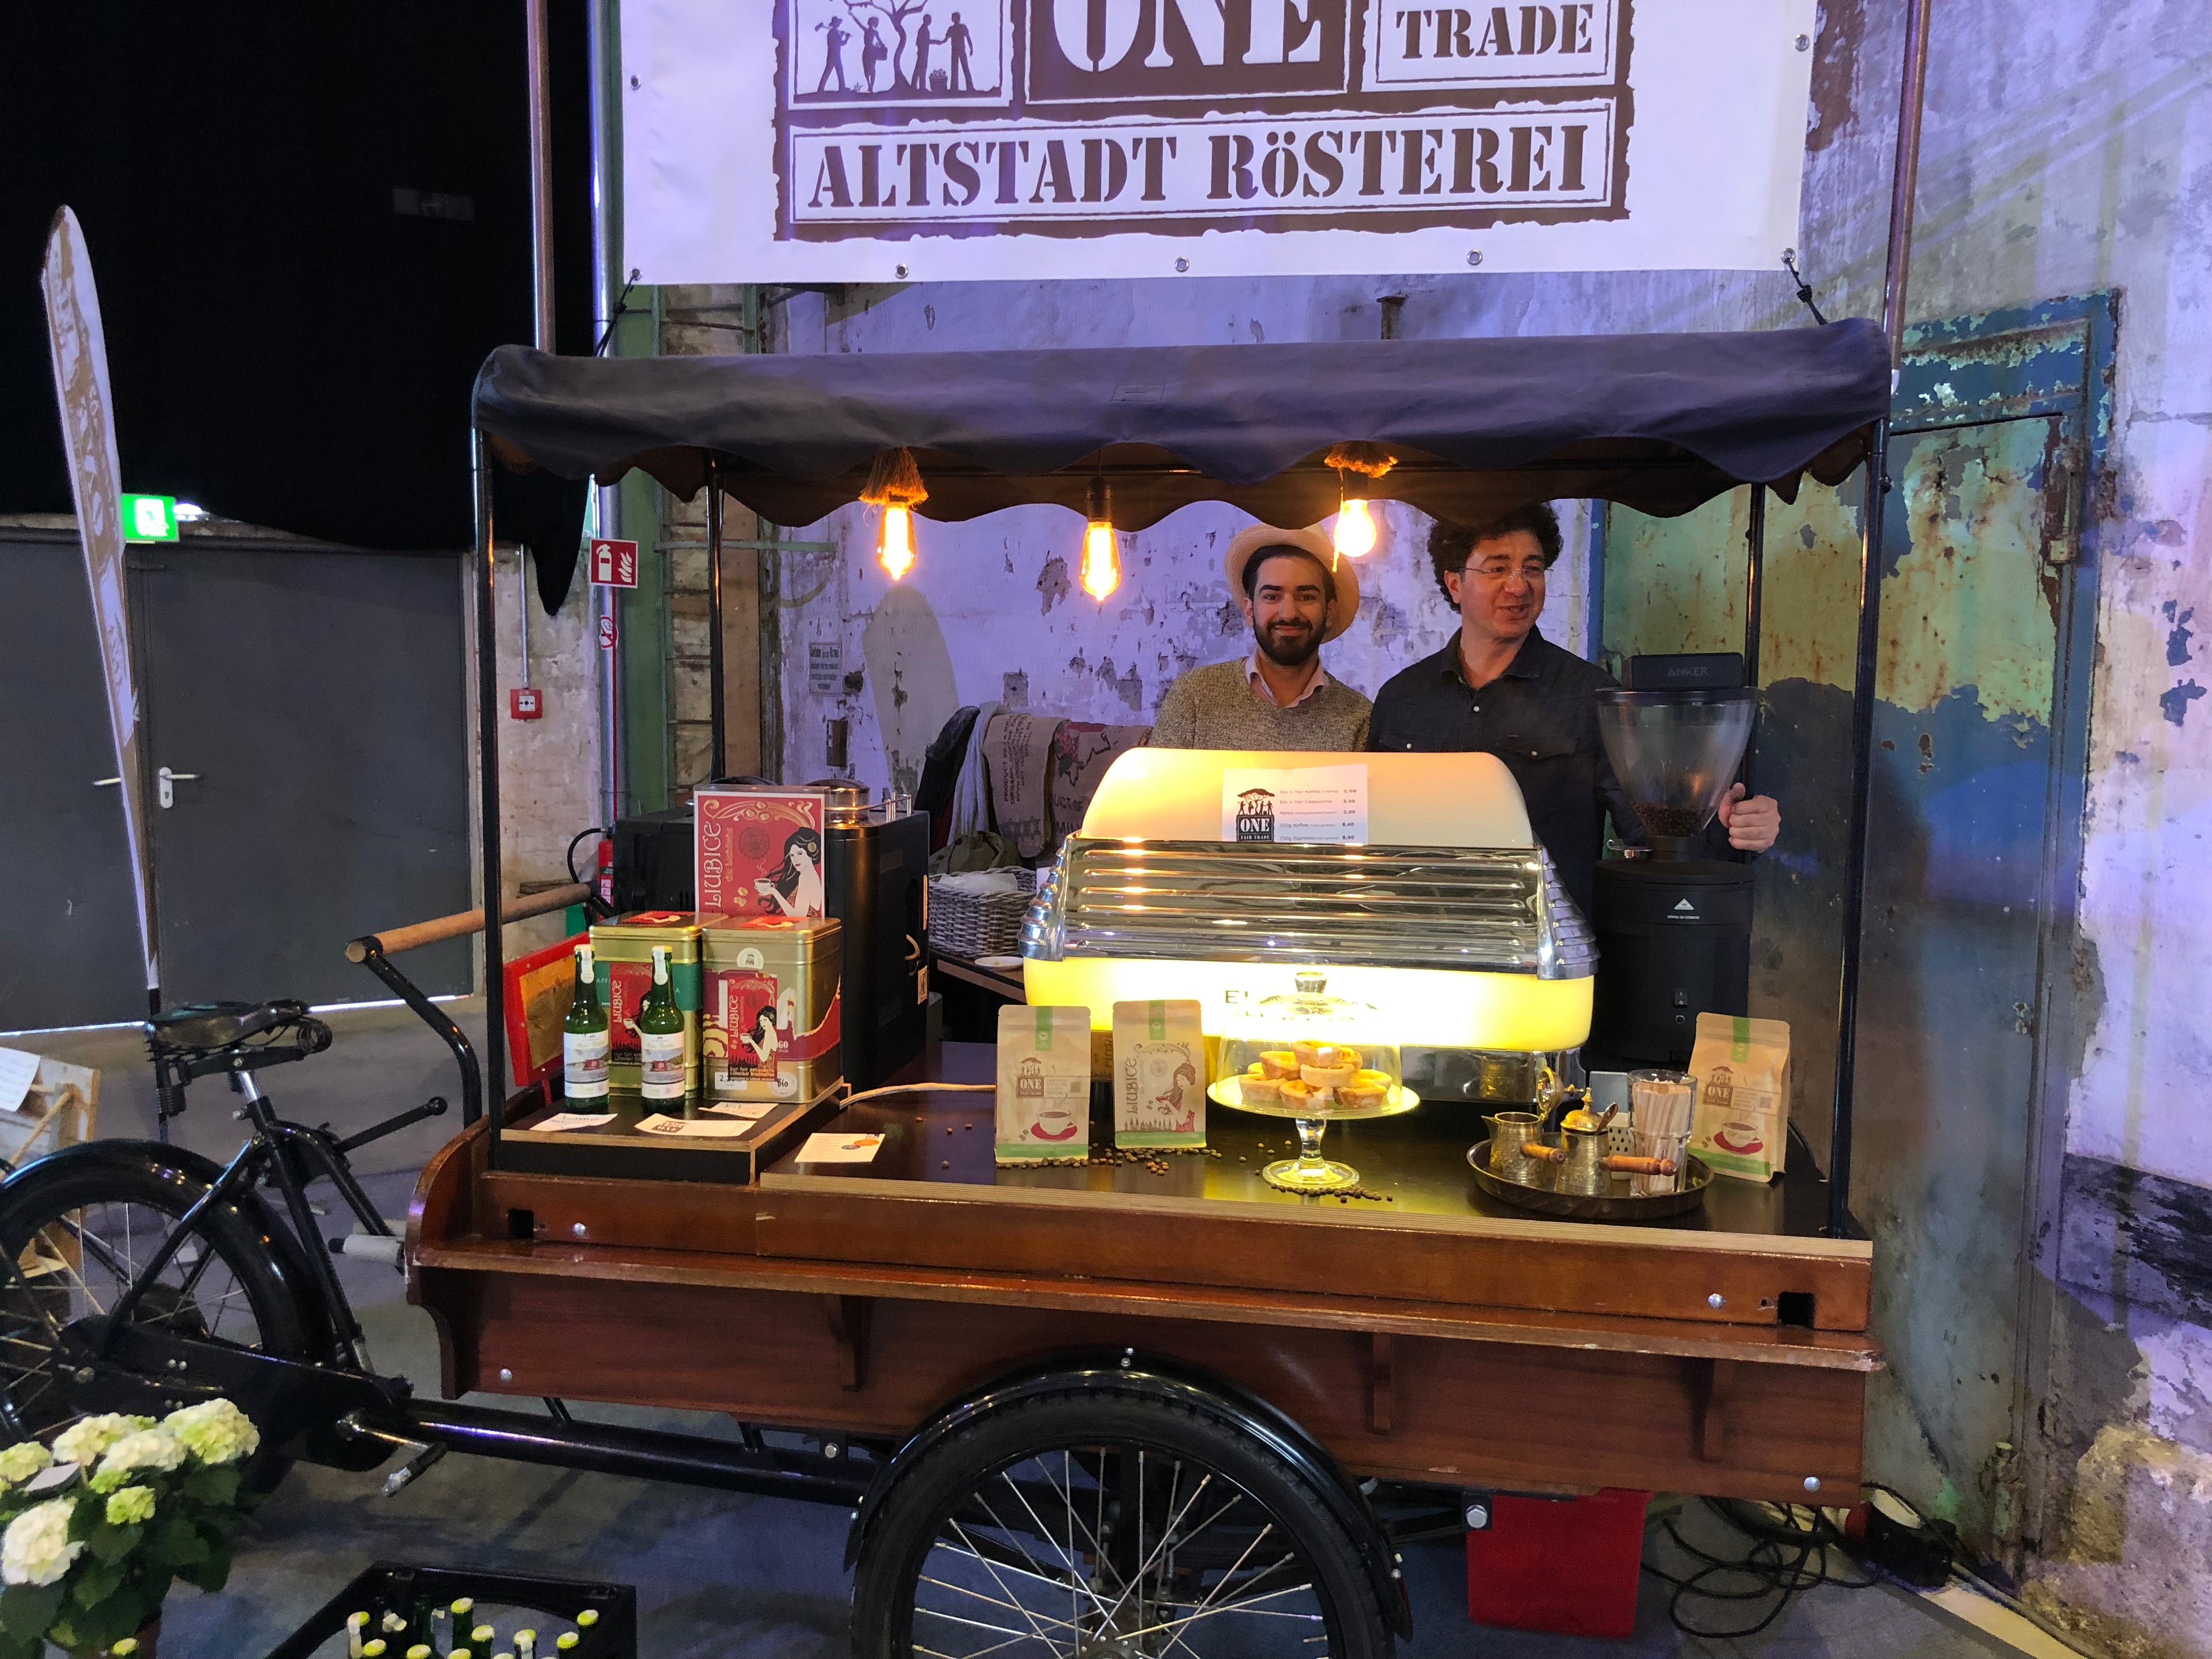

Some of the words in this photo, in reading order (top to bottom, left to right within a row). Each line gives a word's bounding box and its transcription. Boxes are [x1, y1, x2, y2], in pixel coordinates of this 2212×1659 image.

[1396, 4, 1593, 59] TRADE
[808, 137, 1177, 208] ALTSTADT
[1668, 667, 1708, 677] ANKER
[1240, 818, 1269, 832] ONE
[703, 821, 723, 907] LIUBICE
[729, 995, 740, 1037] LIUBICE
[777, 1078, 788, 1087] Bio
[1020, 1079, 1041, 1089] ONE
[1125, 1057, 1139, 1114] LIUBICE
[1708, 1086, 1730, 1098] ONE
